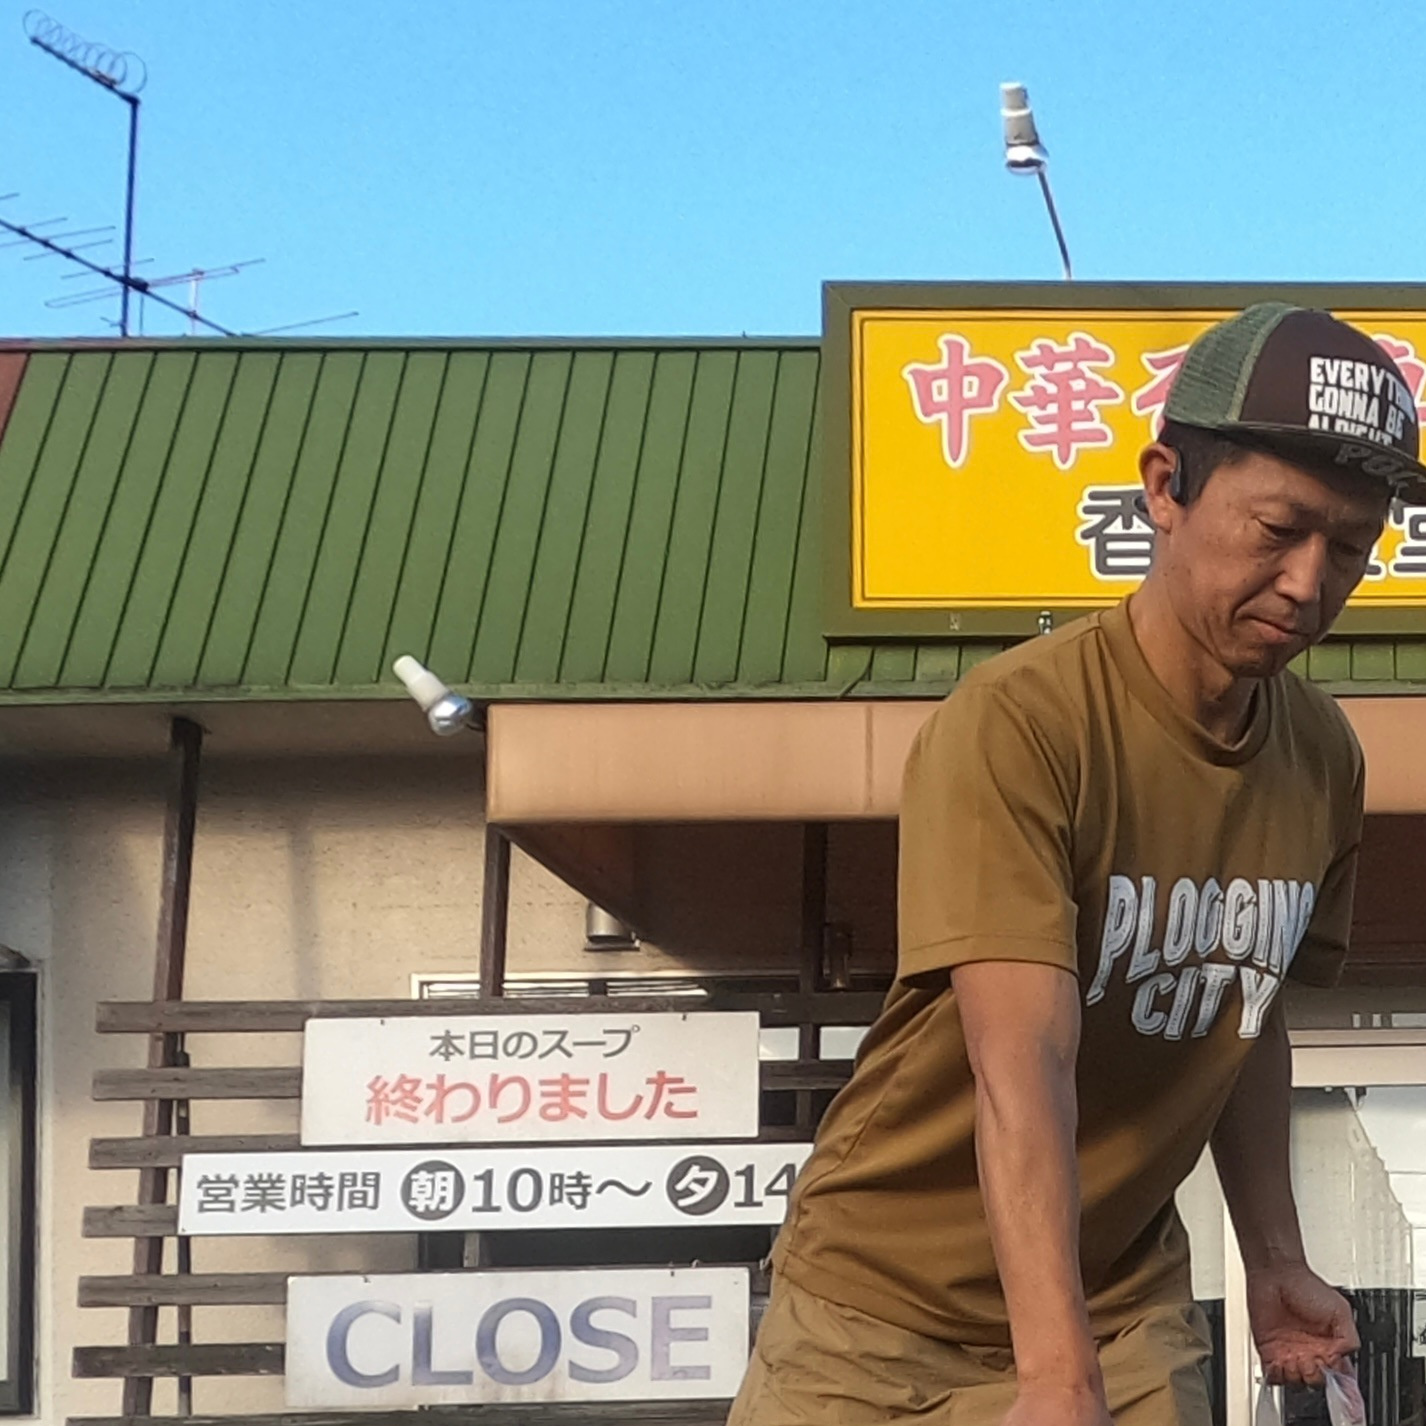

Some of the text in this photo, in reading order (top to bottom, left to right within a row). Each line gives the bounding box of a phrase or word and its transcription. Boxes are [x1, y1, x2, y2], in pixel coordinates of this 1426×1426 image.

[1309, 384, 1406, 440] GONNA BE
[1131, 963, 1281, 1040] CITY
[429, 1025, 640, 1062] 本日のスープ
[365, 1069, 699, 1126] 終わりました
[196, 1171, 381, 1214] 営業時間
[326, 1295, 713, 1389] CLOSE
